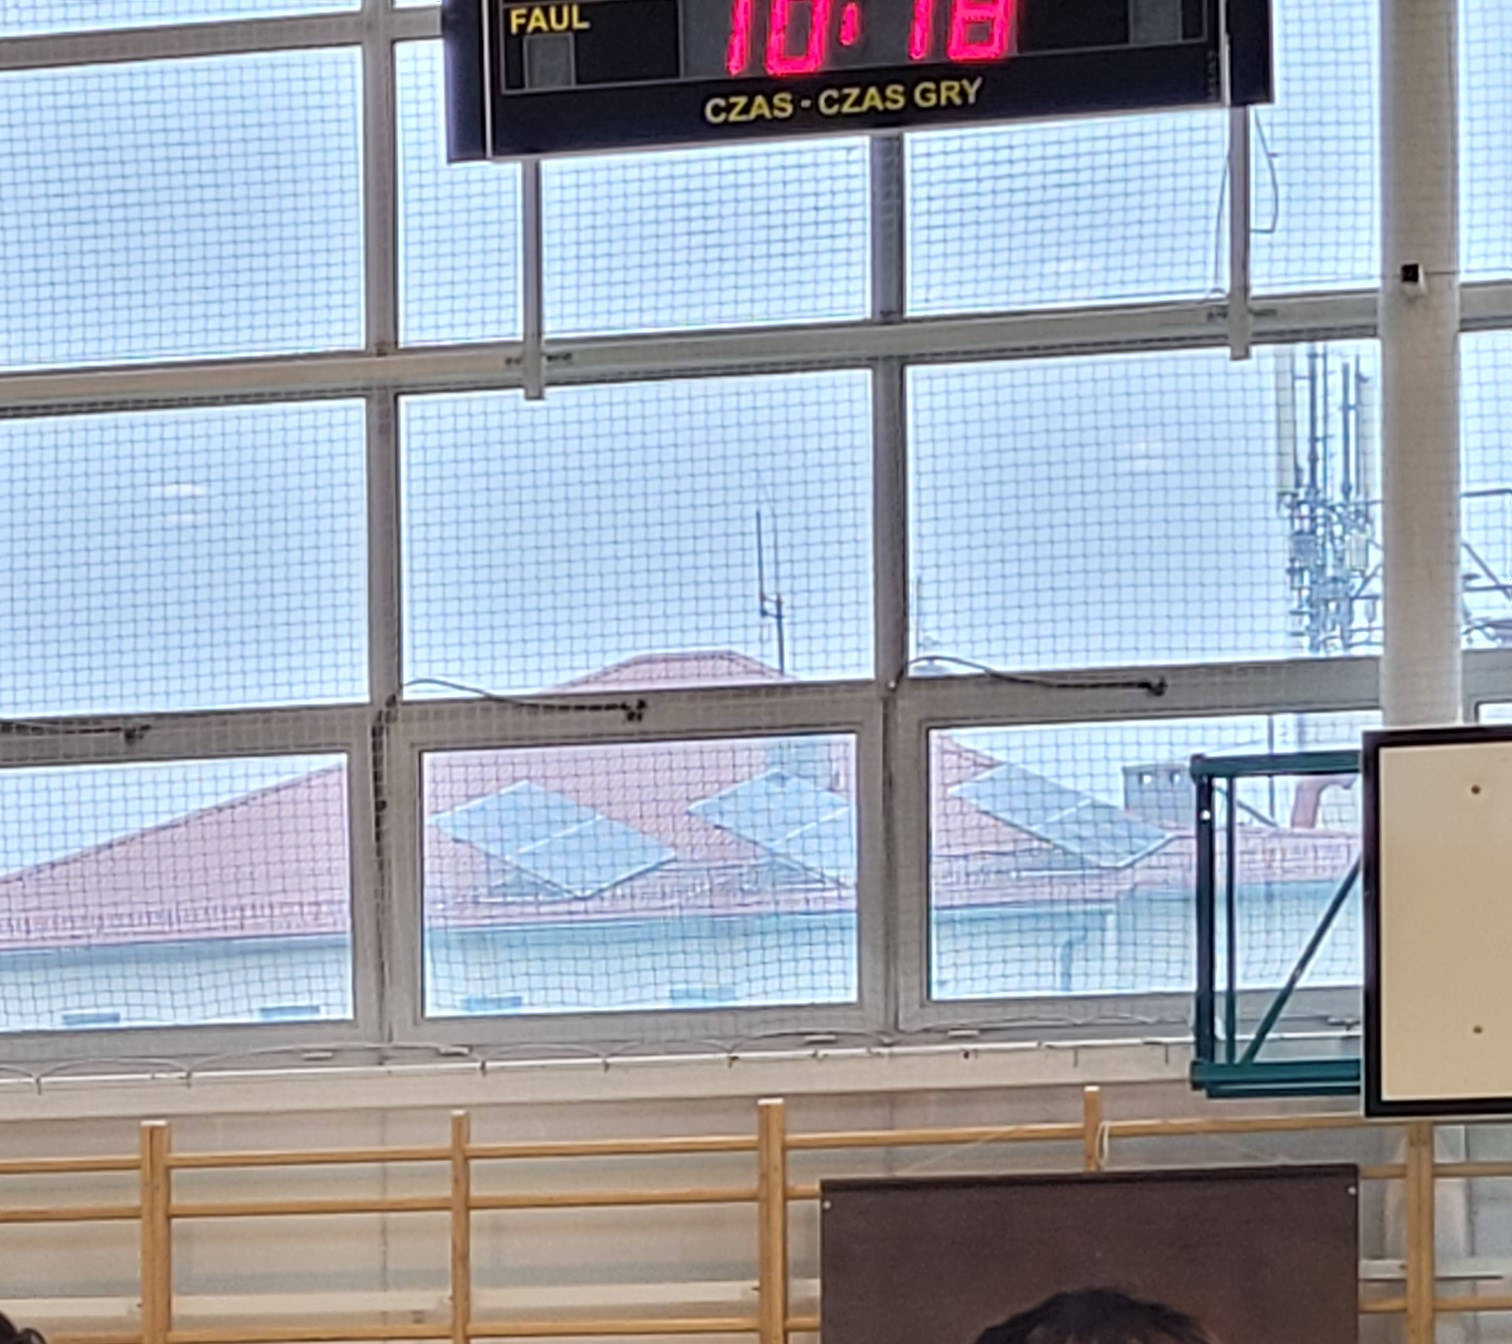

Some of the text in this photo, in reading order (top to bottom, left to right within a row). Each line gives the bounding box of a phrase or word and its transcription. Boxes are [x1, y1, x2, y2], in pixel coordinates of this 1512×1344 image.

[510, 5, 590, 34] FAUL
[704, 93, 793, 124] CZAS
[818, 84, 905, 115] CZAS
[913, 77, 983, 107] GRY
